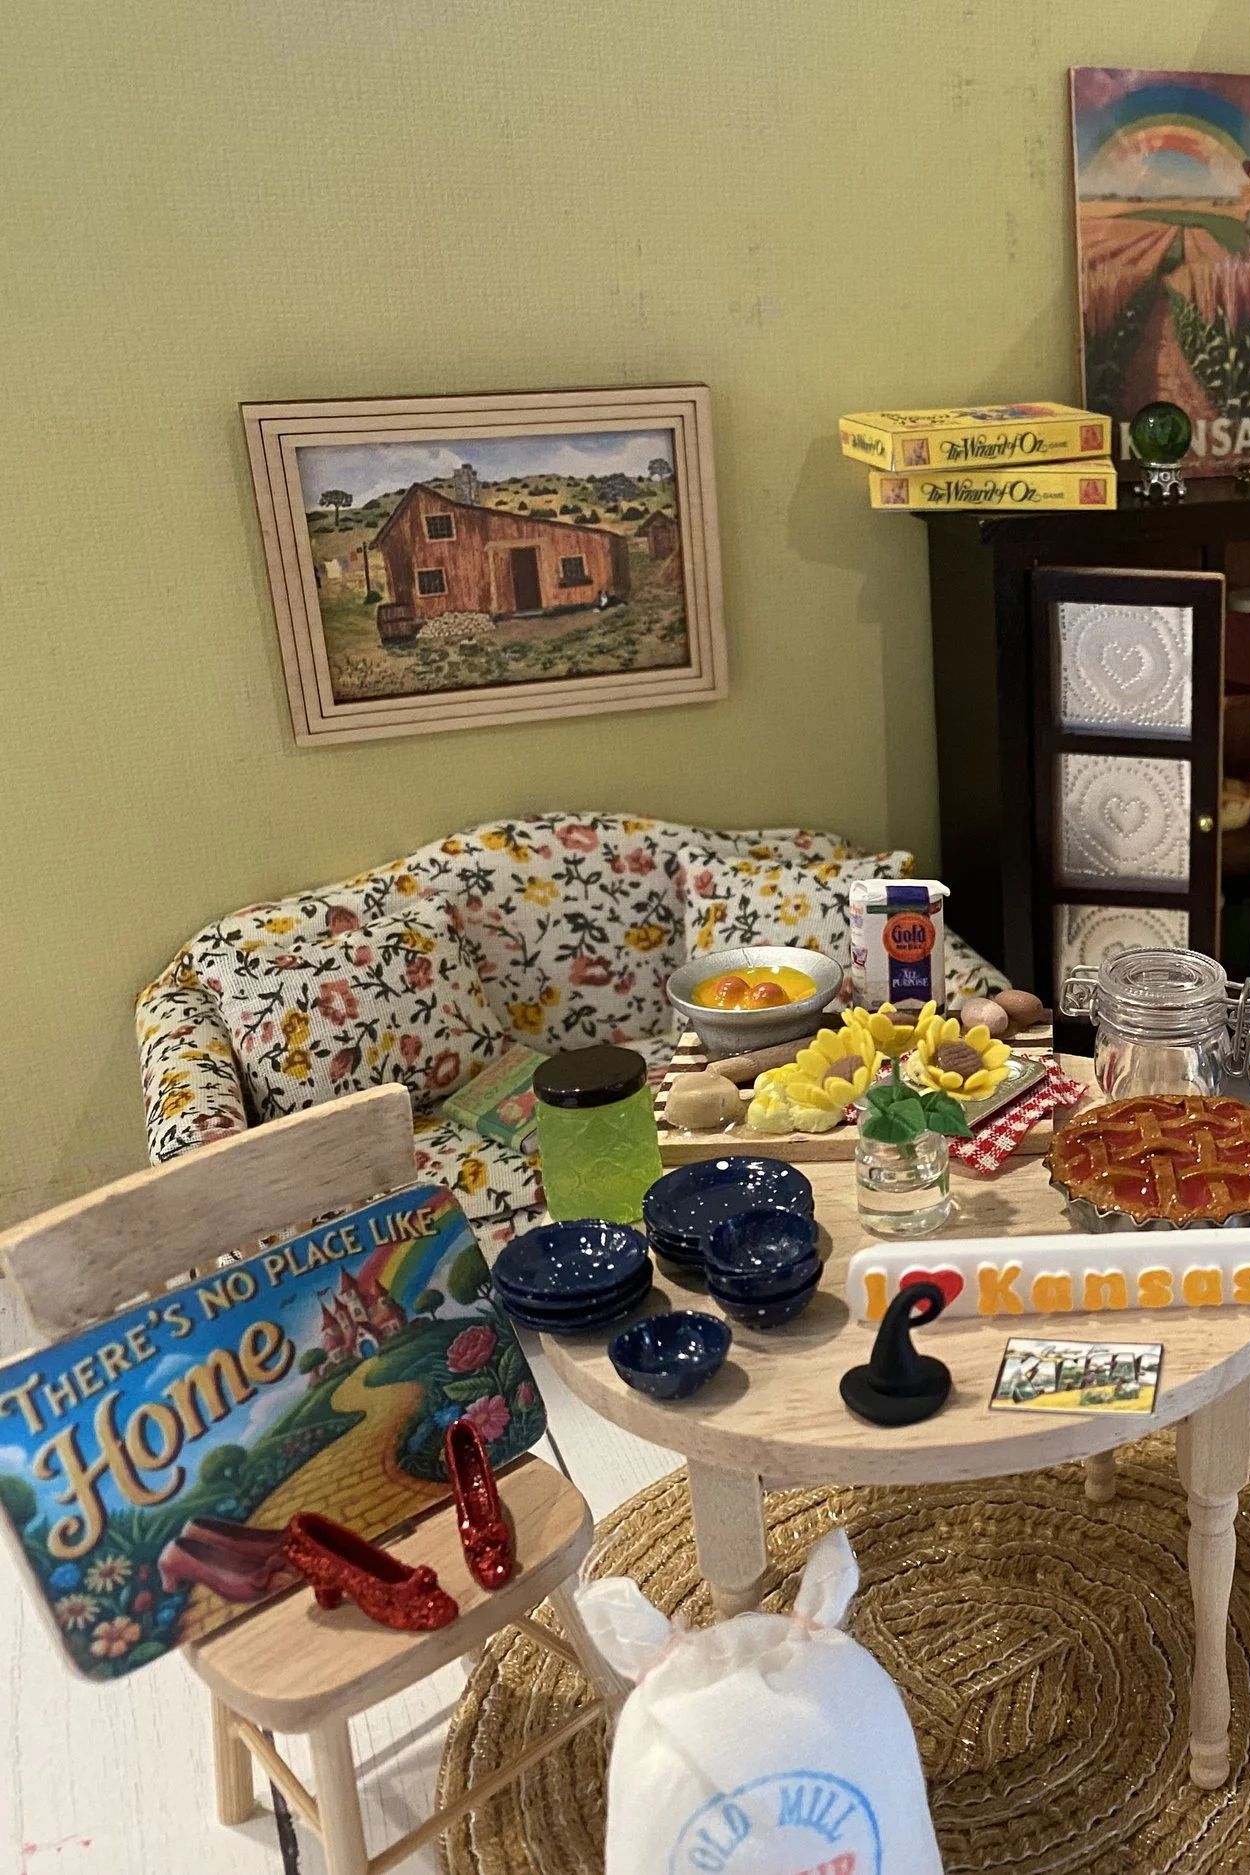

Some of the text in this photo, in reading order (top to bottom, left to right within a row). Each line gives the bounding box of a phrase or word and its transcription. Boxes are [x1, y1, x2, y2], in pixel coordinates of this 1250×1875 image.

[962, 433, 1009, 461] Wizard
[1006, 434, 1022, 459] of
[1020, 431, 1047, 455] Oz
[920, 482, 945, 502] The
[944, 479, 996, 504] Wizard
[994, 481, 1011, 504] of
[1009, 480, 1041, 503] Oz
[892, 924, 926, 943] Gold
[863, 1269, 888, 1321] I
[0, 1207, 440, 1436] THERE'S NO PLACE LIKE
[33, 1319, 296, 1560] Home
[688, 1784, 858, 1874] OLD MILL
